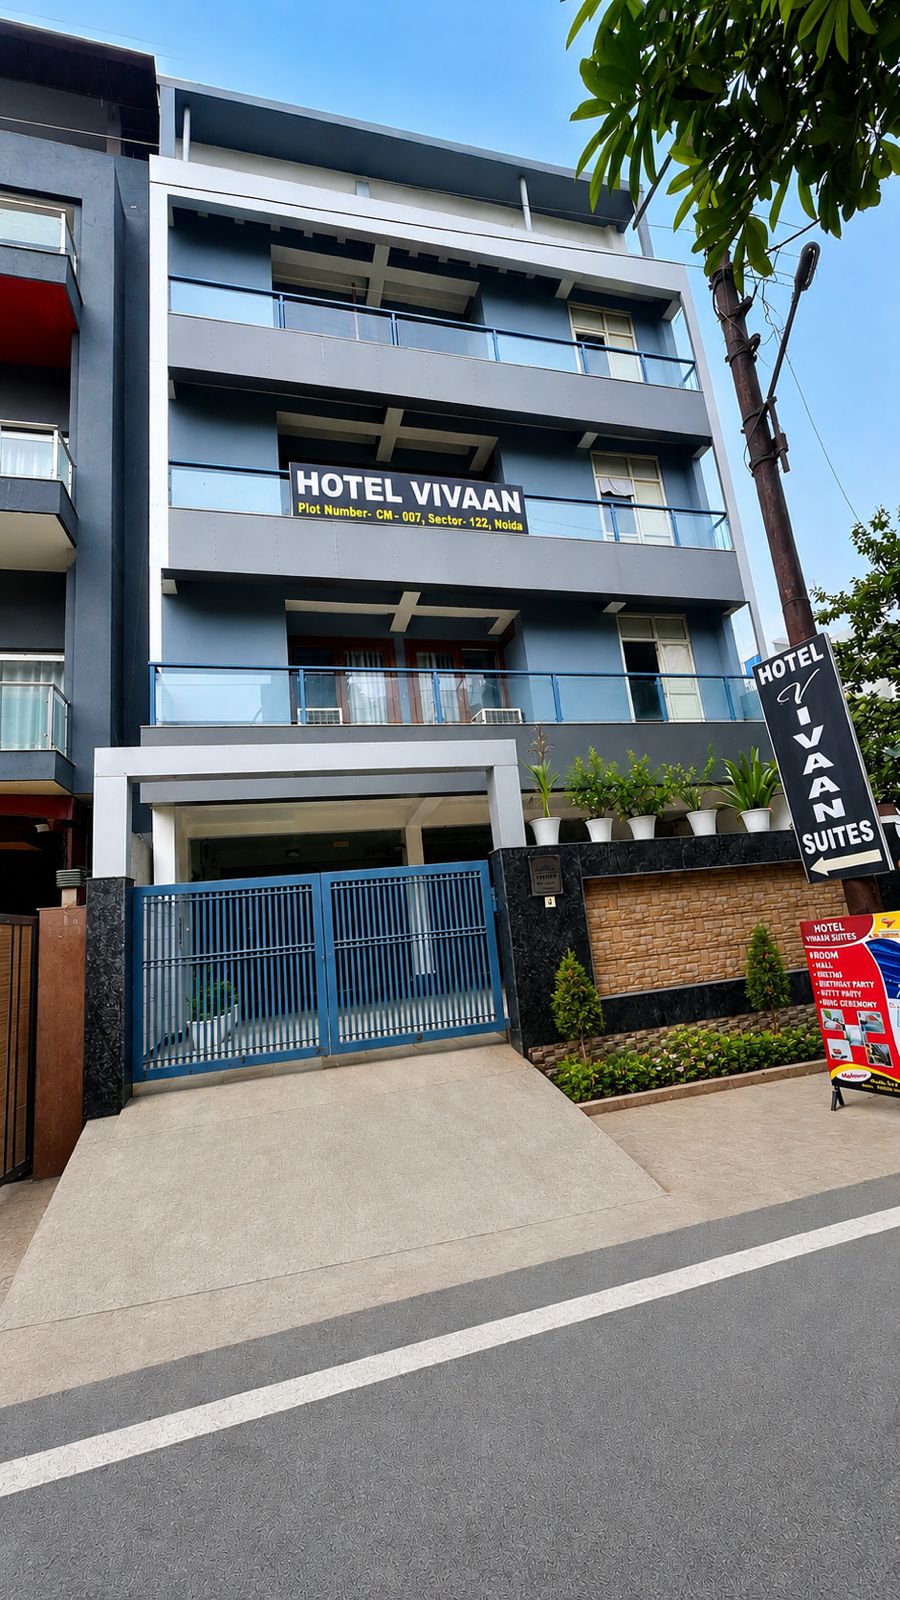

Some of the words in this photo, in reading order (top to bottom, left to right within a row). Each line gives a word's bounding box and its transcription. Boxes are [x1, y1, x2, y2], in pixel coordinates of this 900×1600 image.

[297, 470, 403, 503] HOTEL
[410, 481, 521, 513] VIVAAN
[298, 502, 321, 514] Plot
[324, 504, 372, 518] Number-
[402, 511, 425, 525] 007,
[428, 513, 467, 526] Sector-
[470, 517, 492, 530] 122,
[495, 519, 523, 531] Noida
[758, 642, 824, 686] HOTEL
[777, 668, 846, 823] VIVAAN
[802, 820, 874, 855] SUITES
[814, 922, 845, 933] HOTEL
[831, 932, 857, 942] SUITES
[814, 951, 839, 960] ROOM
[852, 981, 874, 989] PARTY
